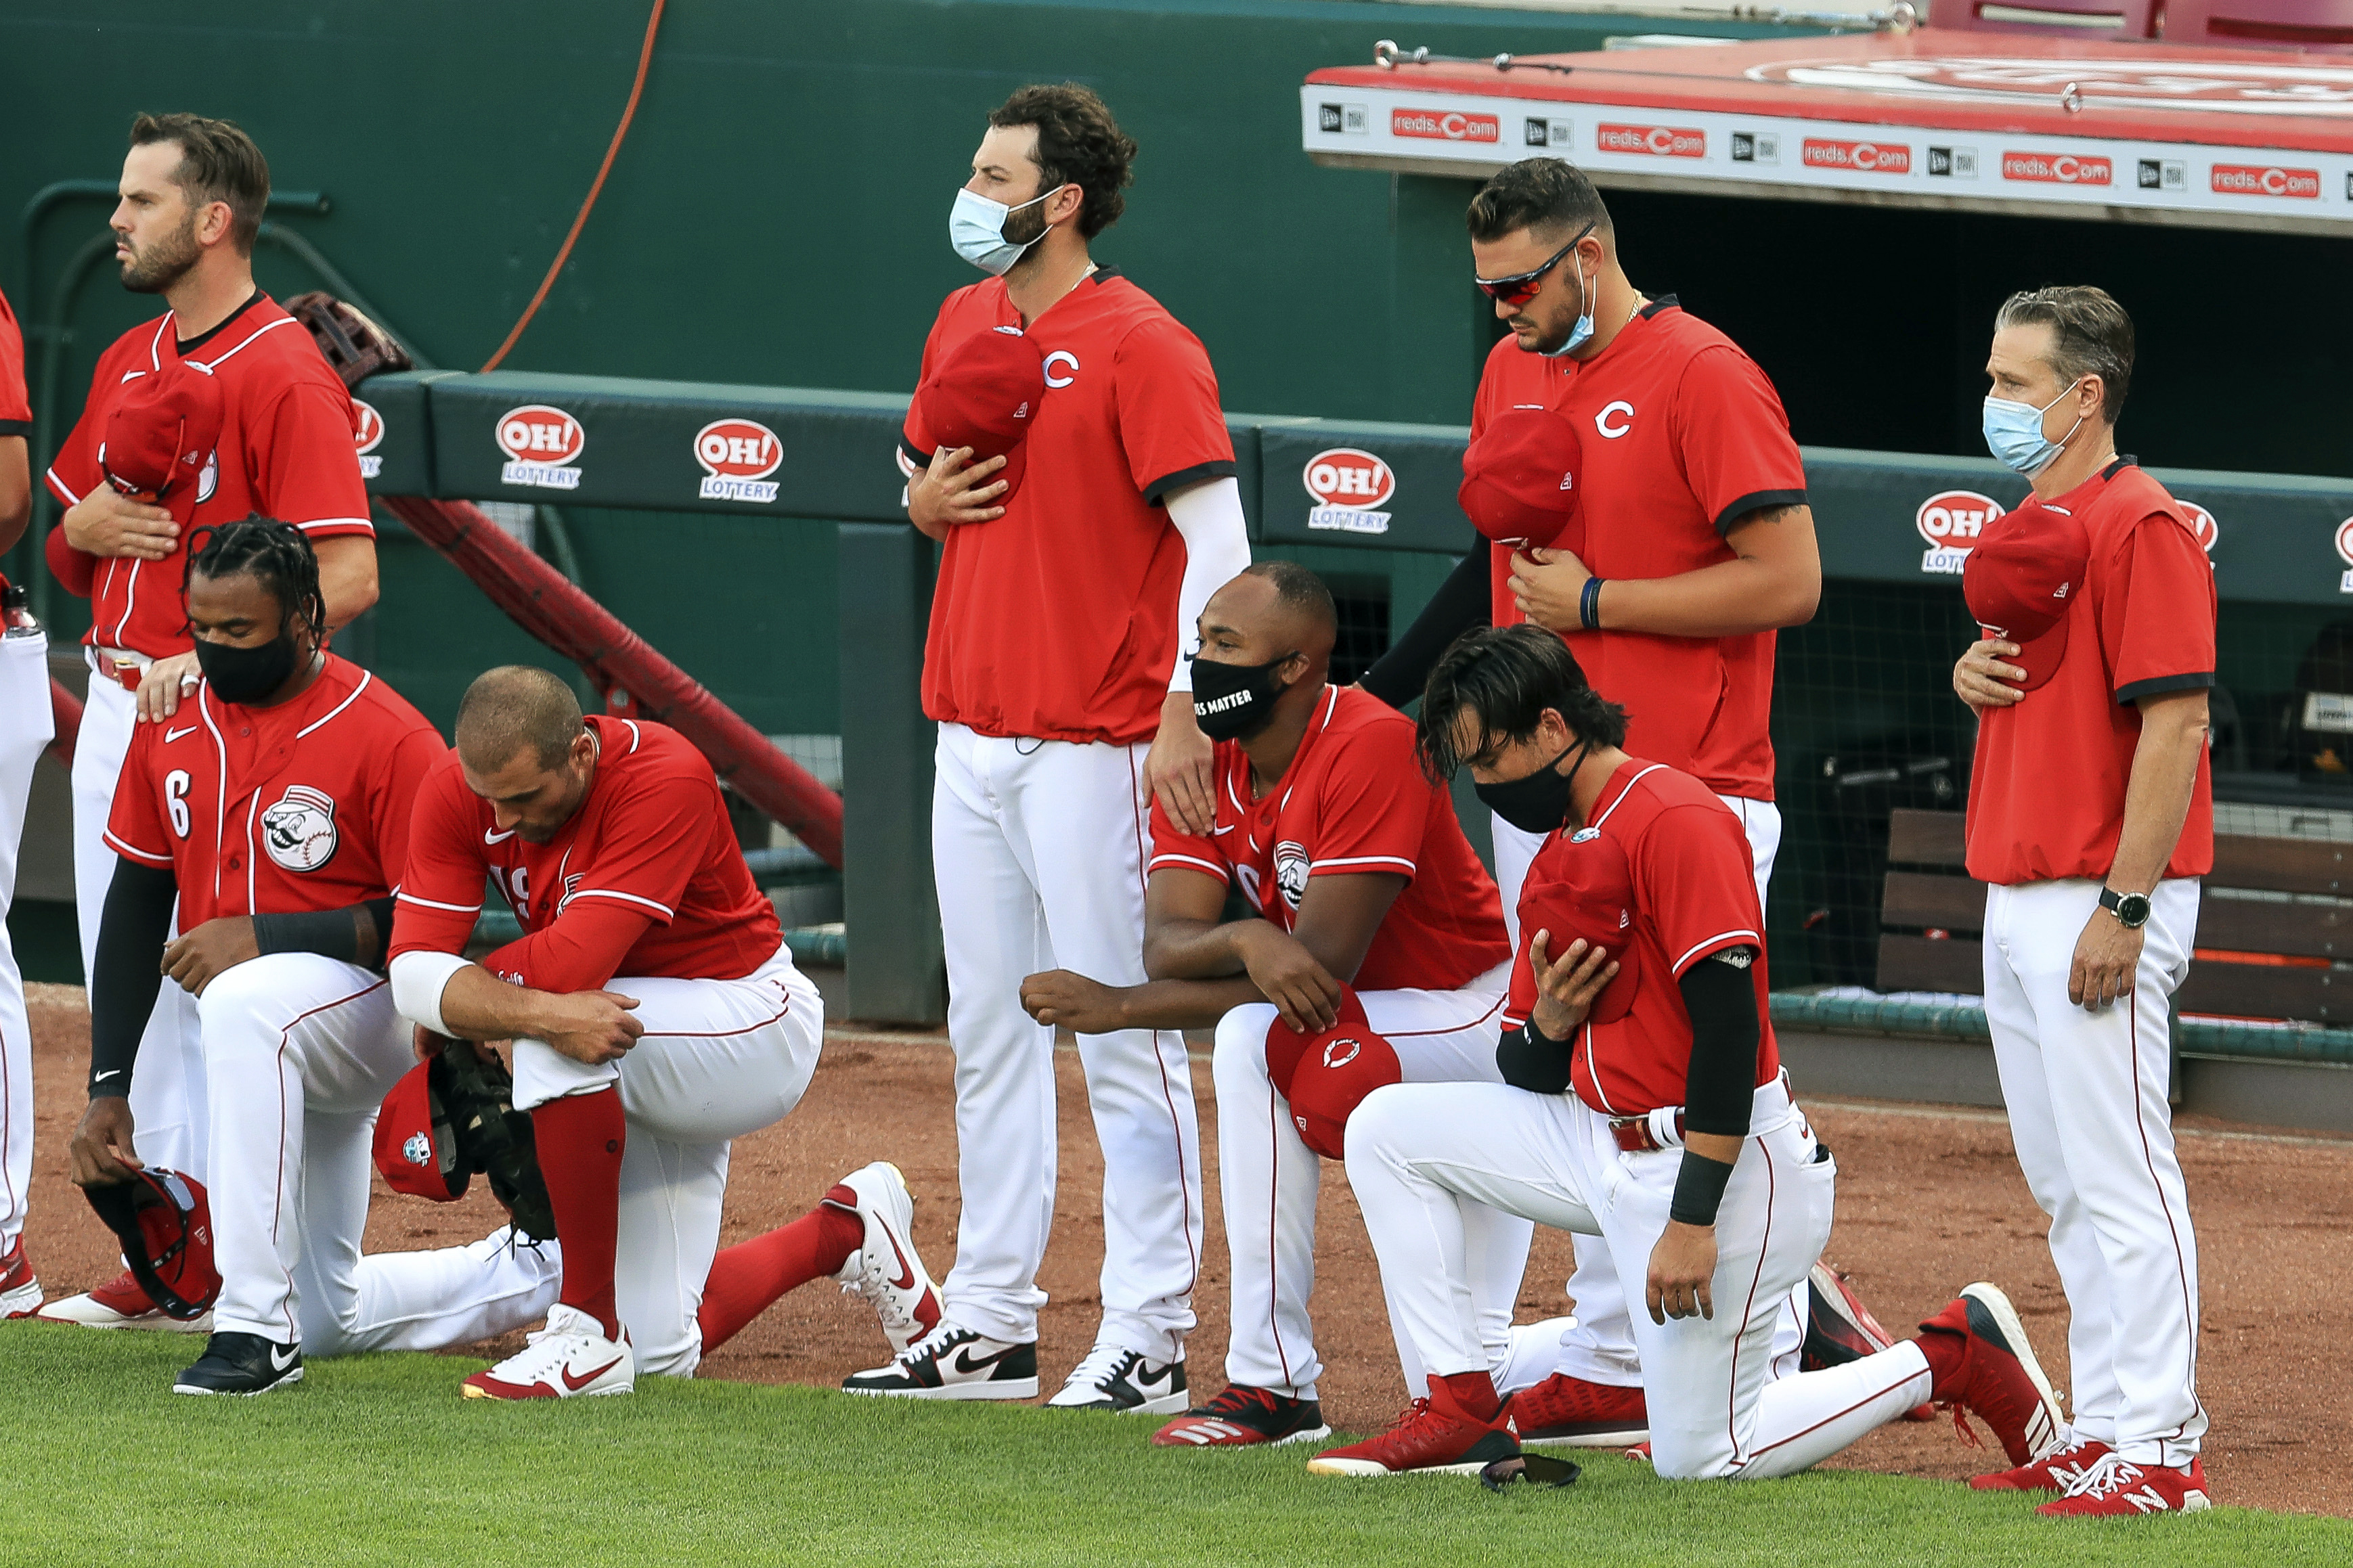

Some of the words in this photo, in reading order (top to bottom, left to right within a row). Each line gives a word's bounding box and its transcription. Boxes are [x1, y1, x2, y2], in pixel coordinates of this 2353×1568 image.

[1042, 350, 1080, 388] C
[1594, 400, 1635, 439] C
[503, 420, 575, 453] OH!
[700, 433, 773, 466] OH!
[1310, 463, 1384, 496] OH!
[1207, 689, 1252, 714] MATTER
[164, 769, 190, 838] 6
